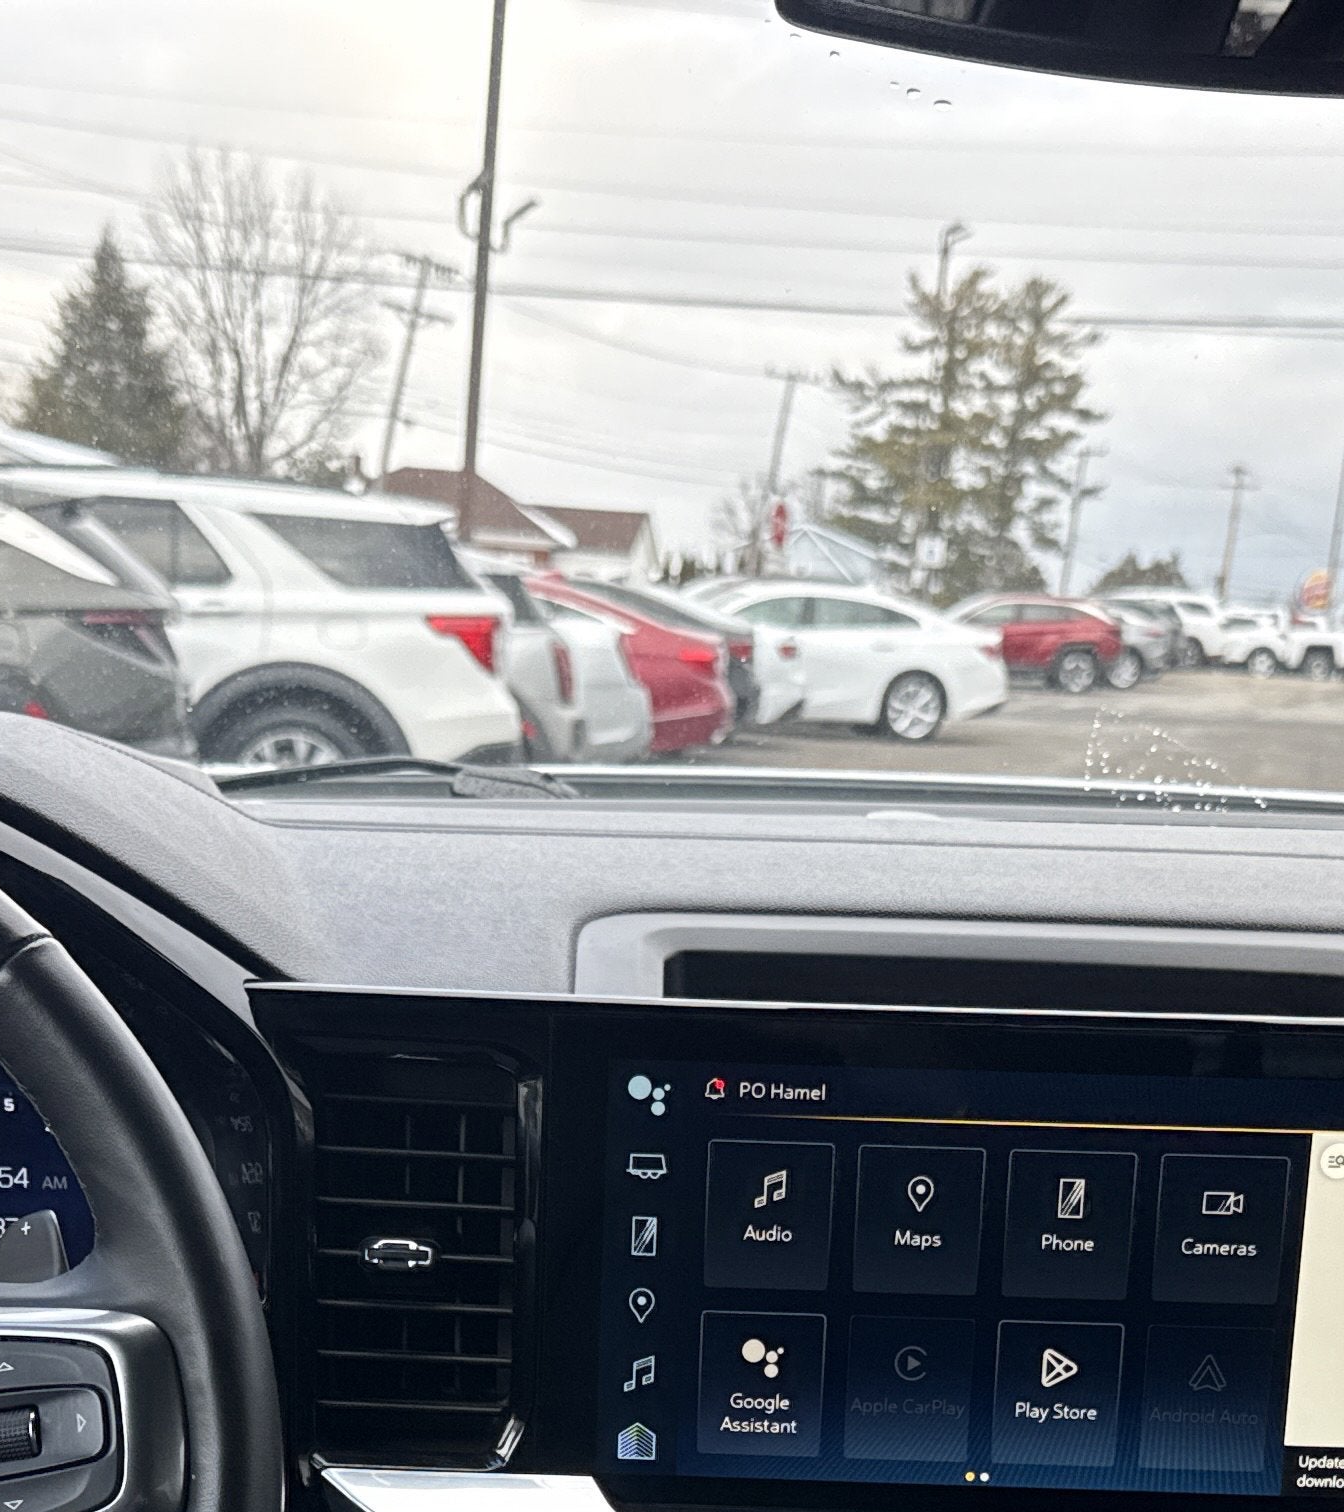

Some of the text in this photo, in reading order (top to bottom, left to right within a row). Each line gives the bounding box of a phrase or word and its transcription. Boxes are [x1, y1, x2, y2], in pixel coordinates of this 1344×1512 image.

[739, 1082, 826, 1101] PO Hamel
[3, 1097, 15, 1111] 5
[42, 1176, 68, 1190] AM
[743, 1225, 793, 1244] Audio
[894, 1230, 942, 1249] Maps
[1041, 1234, 1095, 1253] Phone
[1180, 1238, 1257, 1258] Cameras
[729, 1394, 790, 1415] Google
[850, 1398, 965, 1417] Apple CarPlay
[1015, 1402, 1098, 1422] Play Store
[720, 1416, 797, 1435] Assistant
[1149, 1408, 1259, 1425] Android Auto
